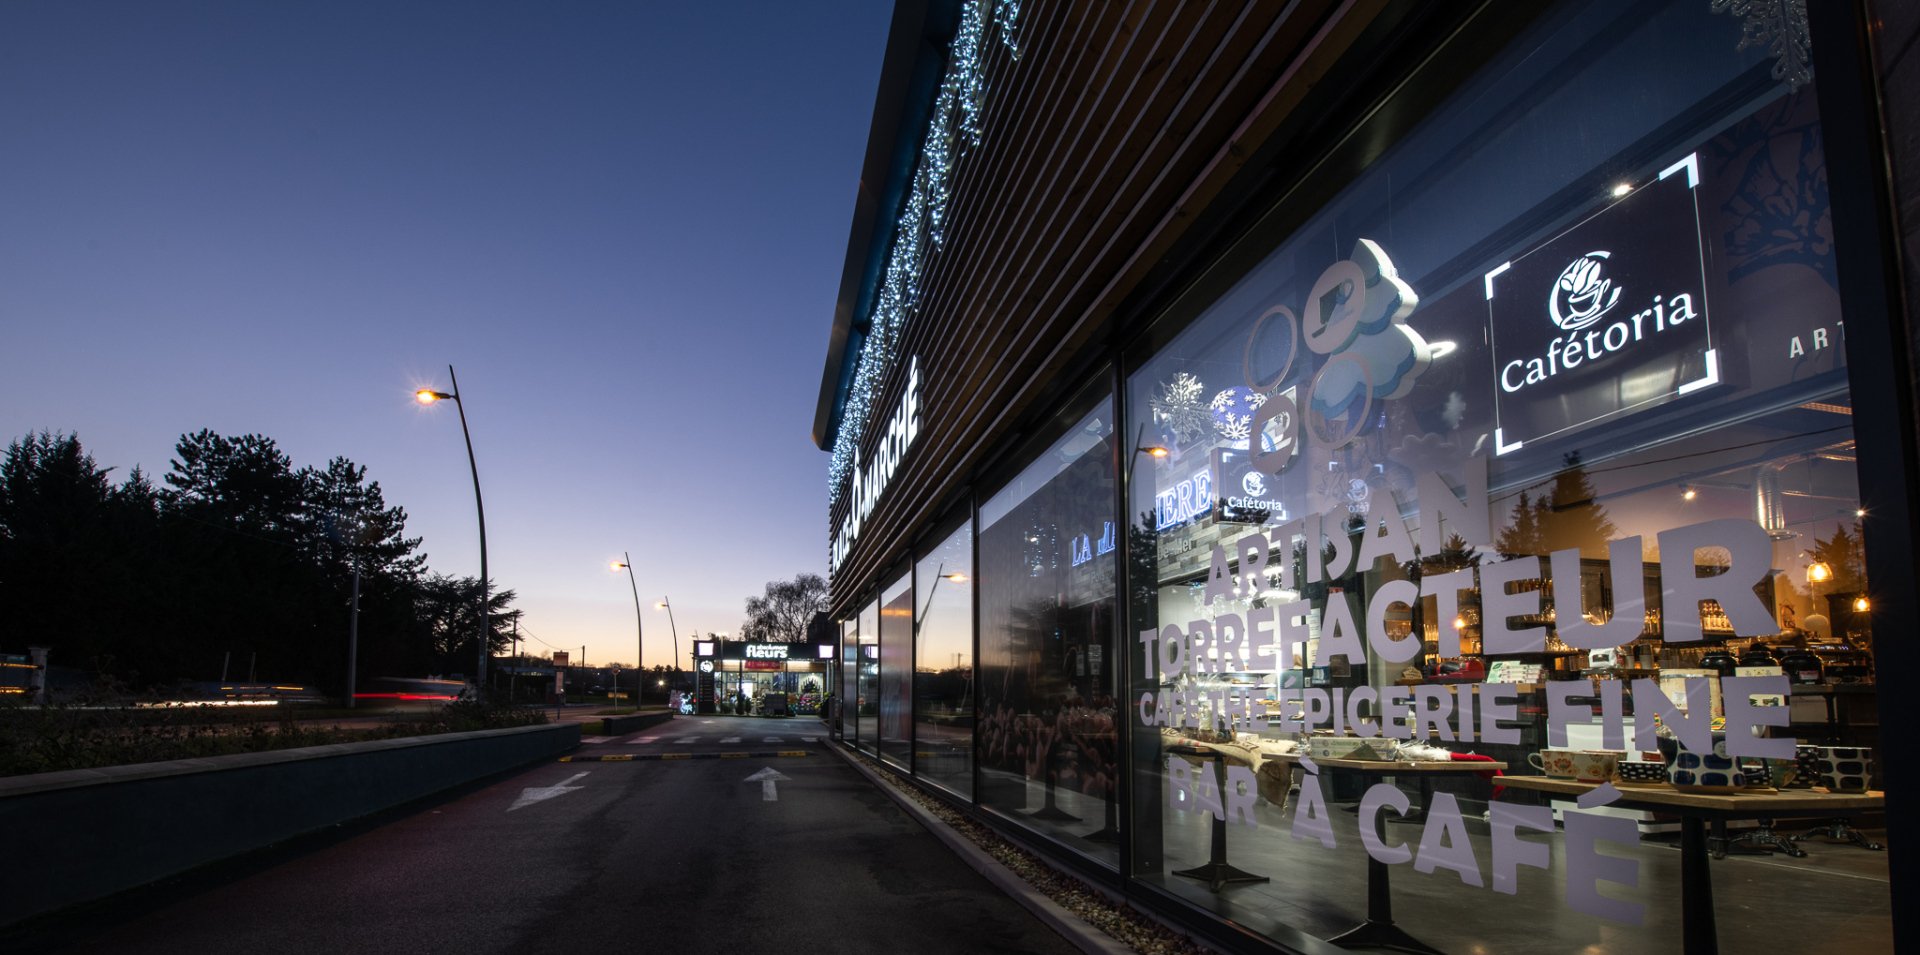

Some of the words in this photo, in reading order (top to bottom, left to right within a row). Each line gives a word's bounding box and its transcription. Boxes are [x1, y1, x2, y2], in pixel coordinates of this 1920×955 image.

[1501, 293, 1697, 393] Cafétoria
[1204, 454, 1491, 606] ARTISAN
[1227, 496, 1283, 512] Cafétoria
[1139, 518, 1781, 679] TORREFACTEUR
[746, 645, 788, 659] fleurs
[1199, 676, 1269, 732] THÉ
[1280, 675, 1521, 745] ÉPICERIE
[1546, 675, 1796, 760] FINE
[1168, 755, 1258, 829] BAR
[1291, 754, 1336, 849] À
[1358, 782, 1644, 926] CAFÉ
